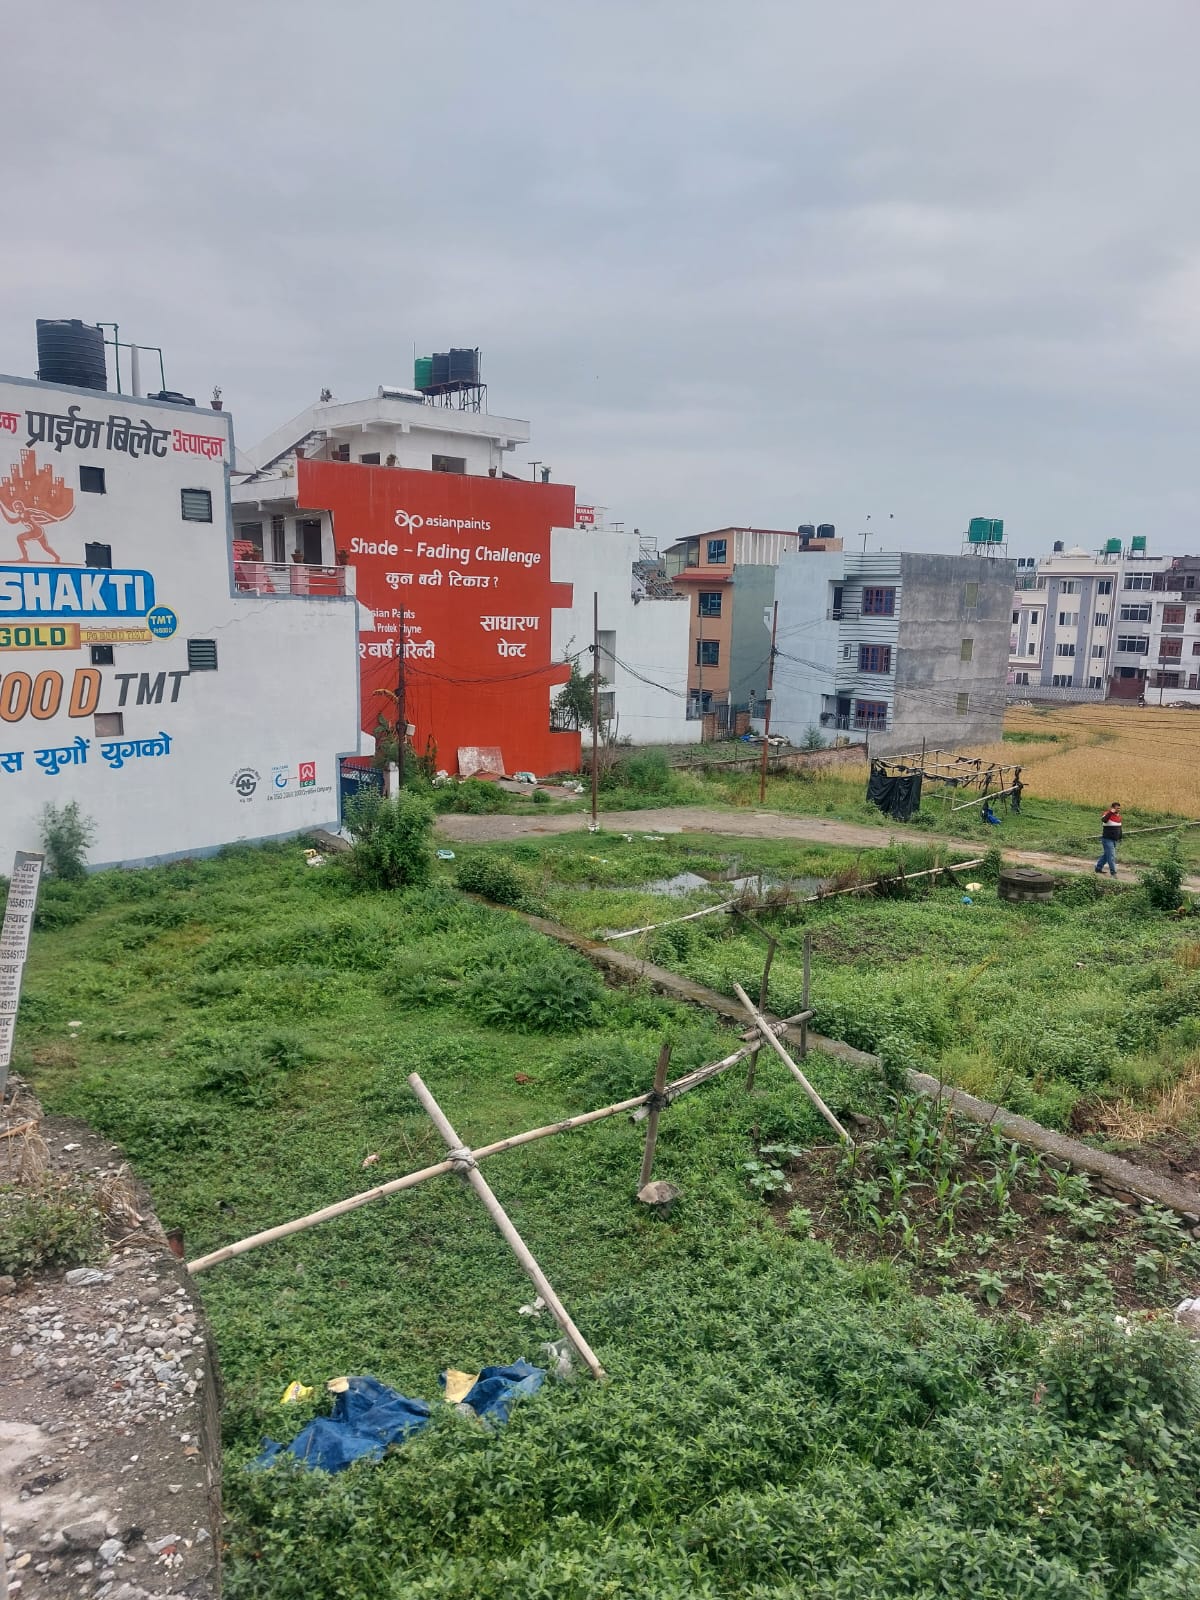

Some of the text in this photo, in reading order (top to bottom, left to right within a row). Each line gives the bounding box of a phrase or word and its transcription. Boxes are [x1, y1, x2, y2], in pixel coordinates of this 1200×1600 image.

[106, 414, 171, 458] बिलेट
[172, 429, 225, 460] उत्पादन
[426, 515, 492, 537] asianpaints
[350, 537, 398, 557] Shade
[417, 542, 470, 565] Fading
[475, 545, 541, 568] Challenge
[385, 571, 414, 590] कुन
[448, 570, 490, 588] टिकाउ
[0, 572, 145, 611] SHAKTI
[150, 615, 173, 624] TMT
[371, 607, 416, 619] sian Pants
[480, 615, 540, 632] साधारण
[0, 627, 66, 648] GOLD
[497, 638, 528, 659] पेन्ट
[115, 671, 190, 706] TMT
[101, 731, 172, 769] युगको
